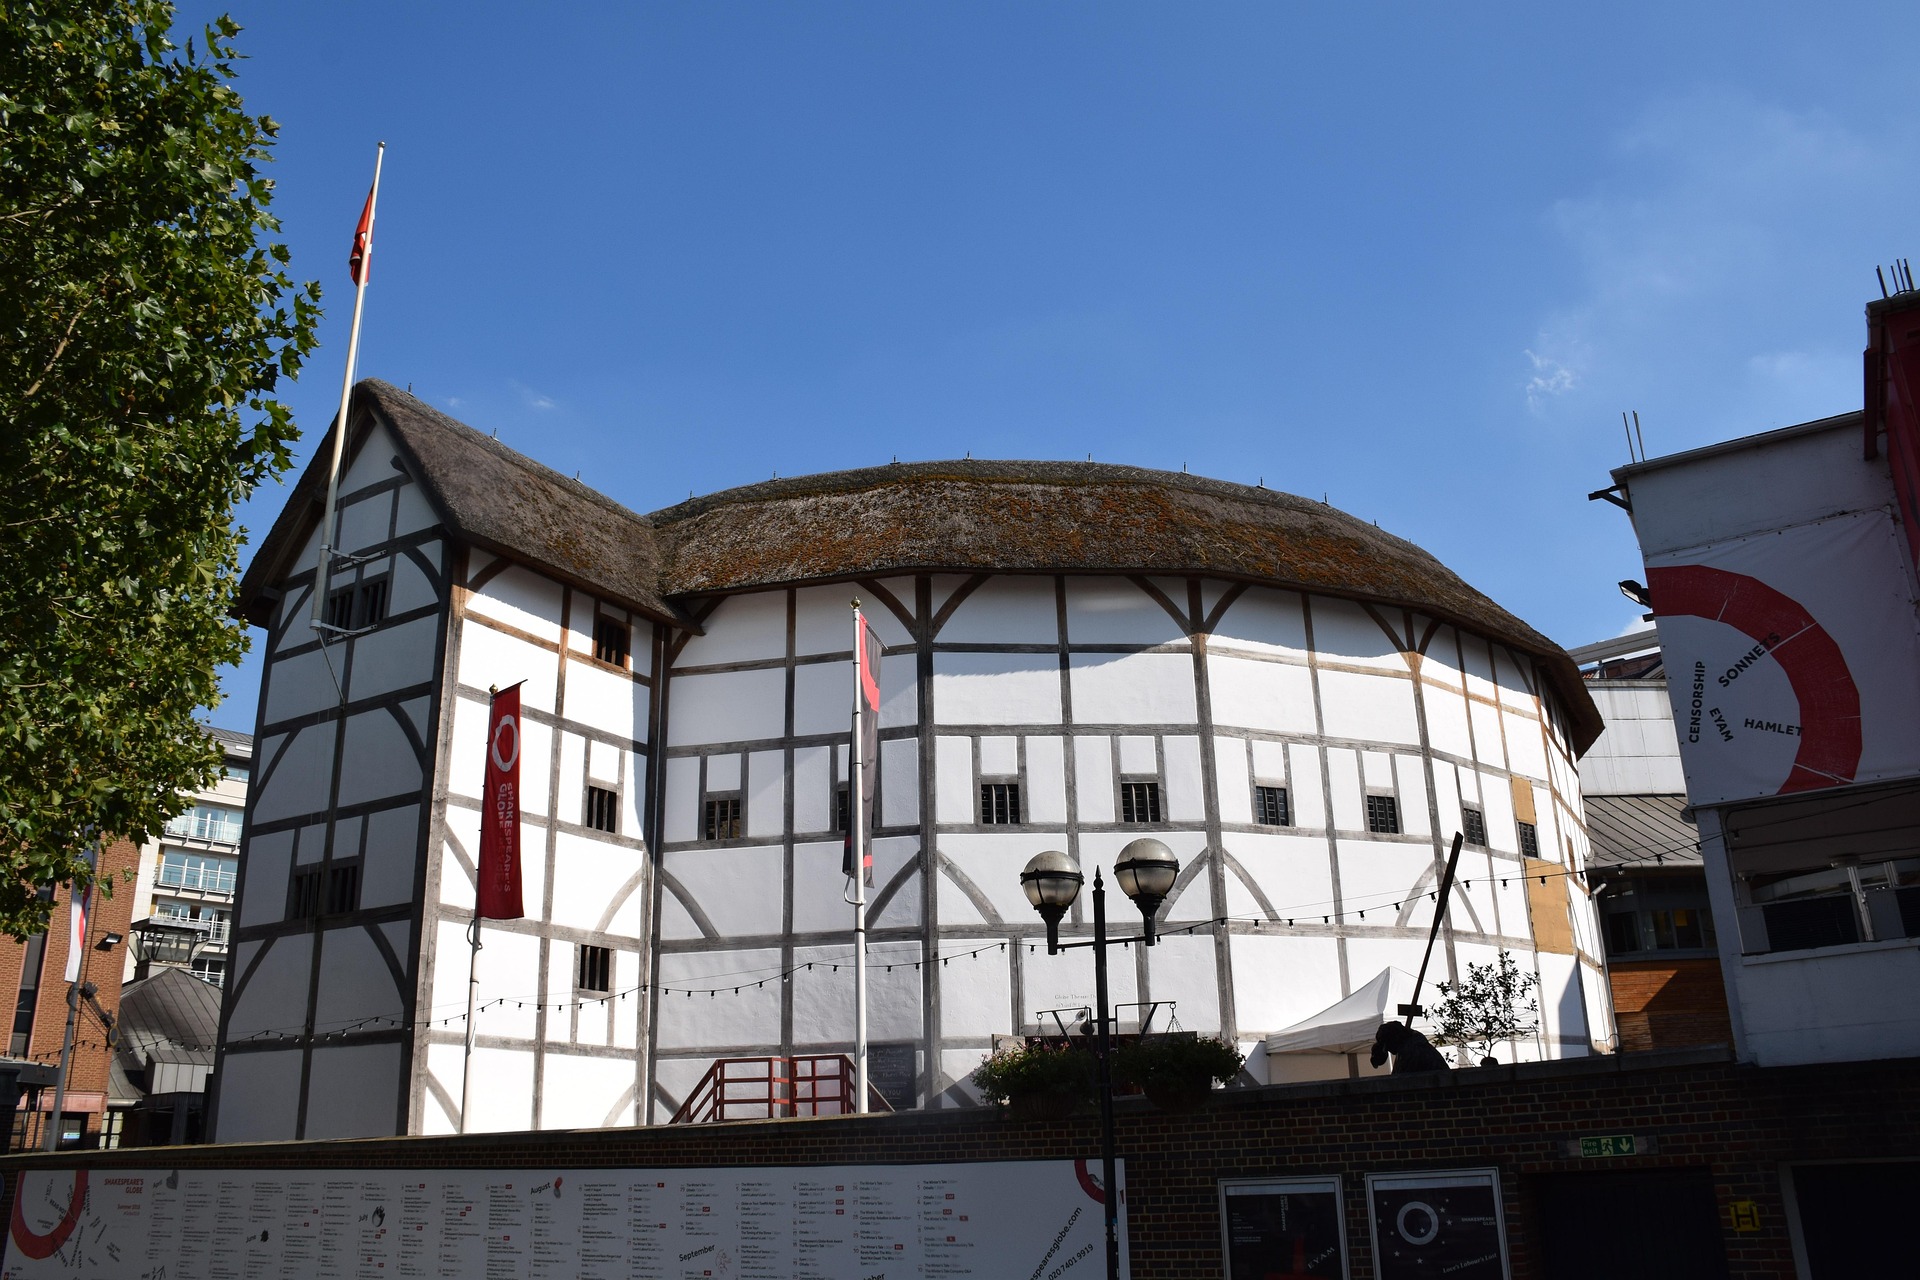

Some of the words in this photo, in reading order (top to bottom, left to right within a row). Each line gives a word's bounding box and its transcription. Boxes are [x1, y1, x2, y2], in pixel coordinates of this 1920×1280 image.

[1718, 632, 1781, 688] SONNETS
[1688, 661, 1706, 743] CENSORSHIP
[1709, 707, 1734, 742] EYAM
[1744, 718, 1804, 736] HAMLET
[504, 782, 514, 892] SHAKESPEARE'S
[530, 1182, 551, 1195] August
[1734, 1204, 1756, 1228] H
[679, 1244, 715, 1262] September
[1048, 1268, 1061, 1280] 020
[1060, 1256, 1077, 1272] 7401
[1077, 1243, 1094, 1260] 9919
[1307, 1246, 1336, 1270] EYAM
[1443, 1264, 1459, 1274] Love's
[1460, 1257, 1484, 1268] Labour's
[1485, 1253, 1497, 1261] Lost
